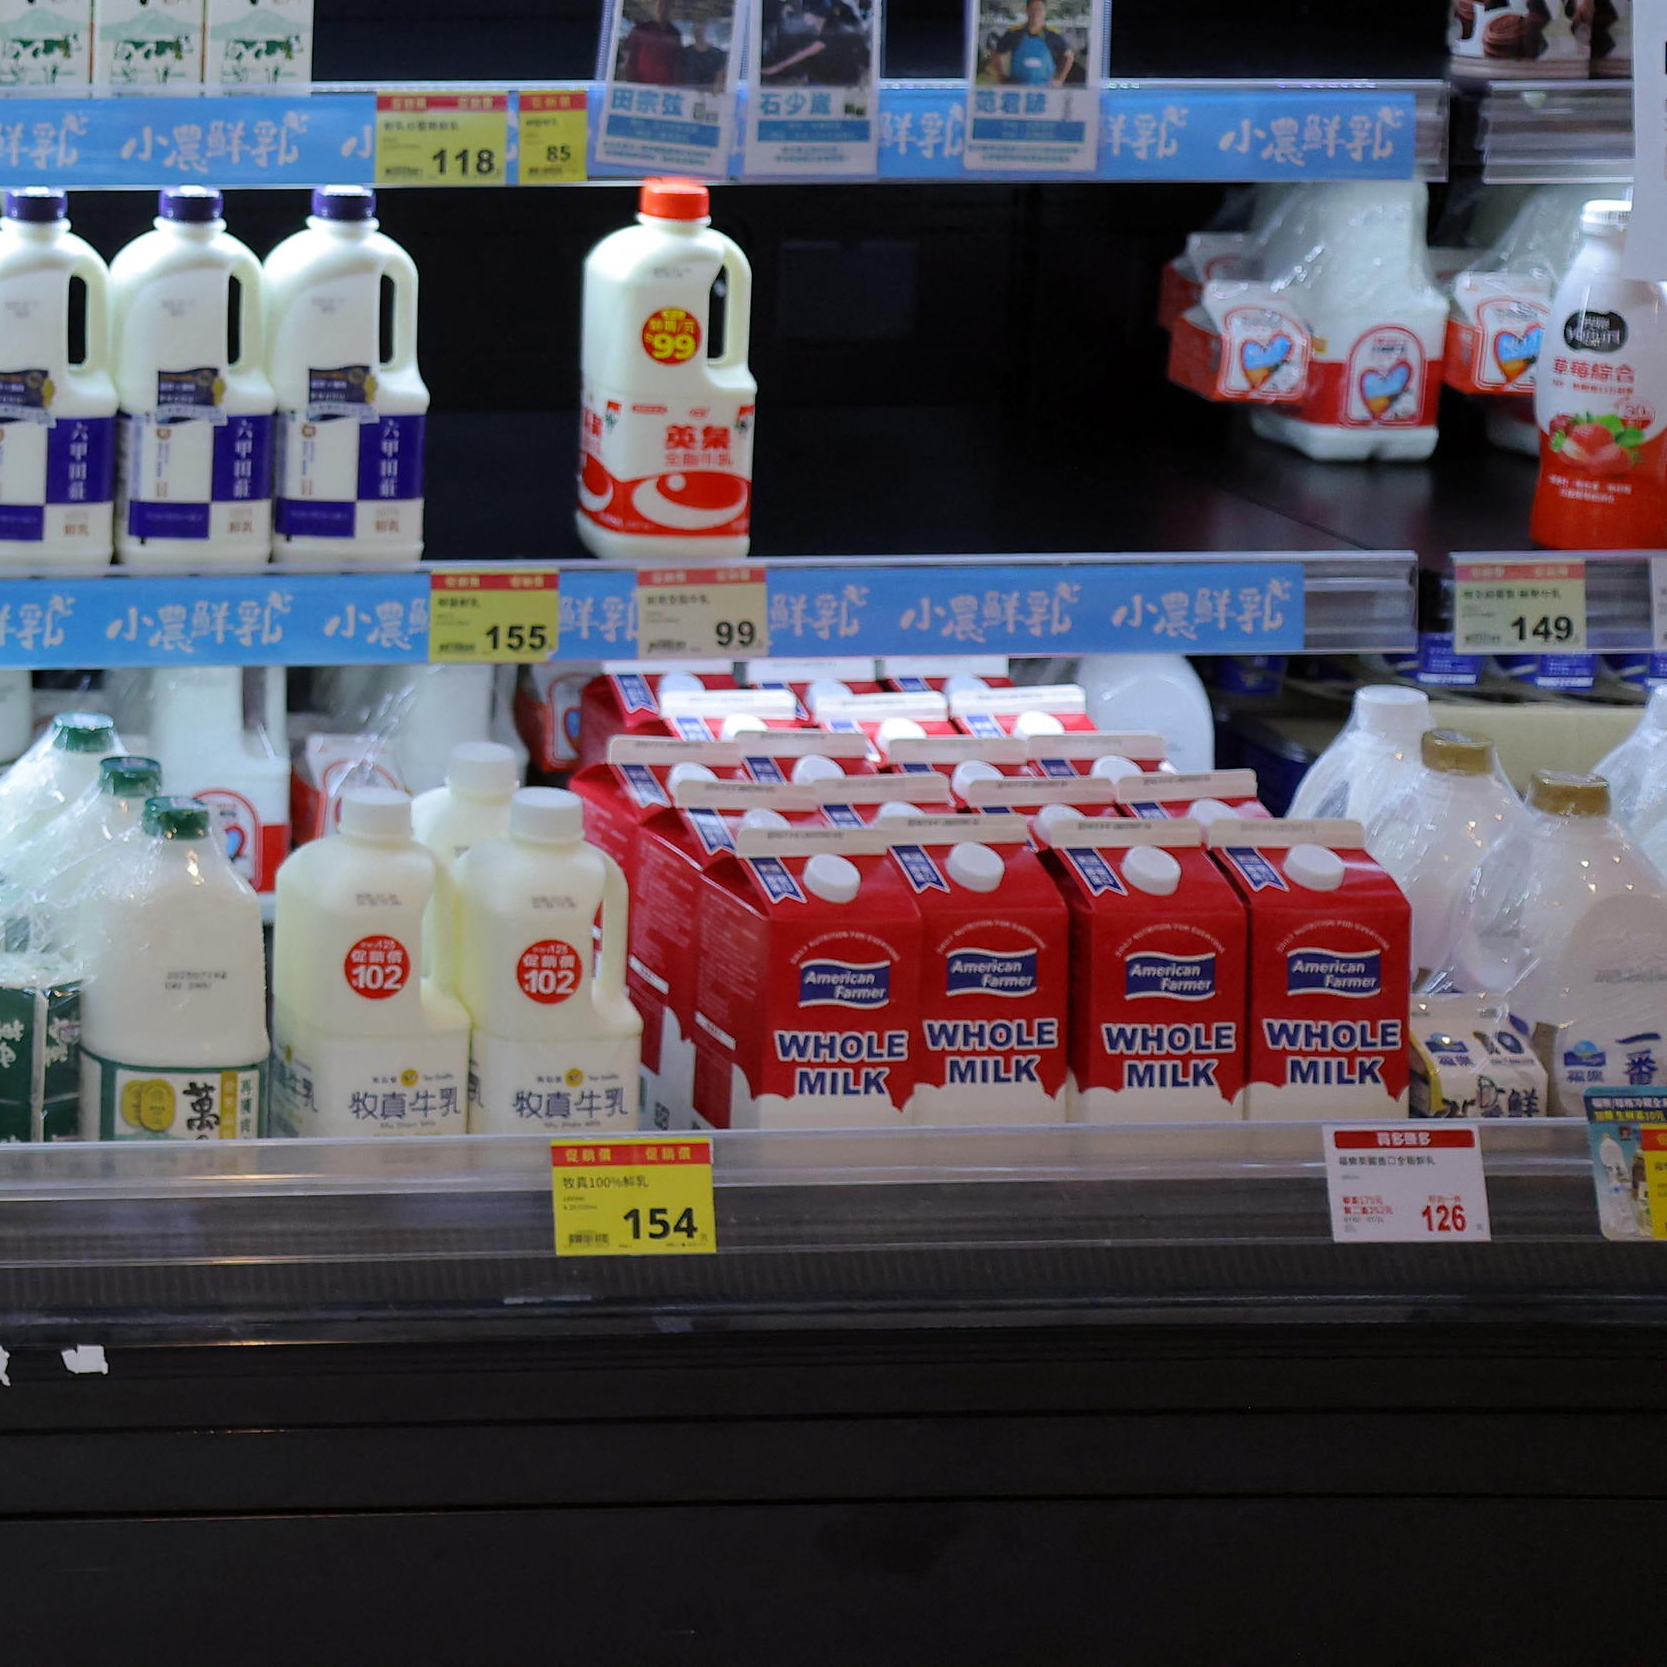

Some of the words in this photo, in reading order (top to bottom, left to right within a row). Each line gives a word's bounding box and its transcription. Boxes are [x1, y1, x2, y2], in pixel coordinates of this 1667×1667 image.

[433, 148, 495, 174] 118
[547, 145, 570, 162] 85
[649, 330, 696, 364] 99
[485, 626, 546, 651] 155
[714, 621, 756, 646] 99
[1511, 616, 1573, 642] 149
[805, 971, 875, 985] American
[951, 960, 1021, 973] American
[1130, 963, 1201, 977] American
[1292, 960, 1365, 973] American
[834, 985, 886, 999] Farmer
[981, 973, 1033, 987] Farmer
[1160, 977, 1211, 991] Farmer
[1324, 974, 1377, 988] Farmer
[775, 1031, 908, 1062] WHOLE
[924, 1020, 1057, 1050] WHOLE
[1102, 1024, 1235, 1054] WHOLE
[1263, 1020, 1400, 1050] WHOLE
[796, 1069, 889, 1096] MILK
[948, 1057, 1039, 1084] MILK
[1126, 1061, 1217, 1088] MILK
[624, 1208, 698, 1239] 154
[1422, 1205, 1466, 1231] 126
